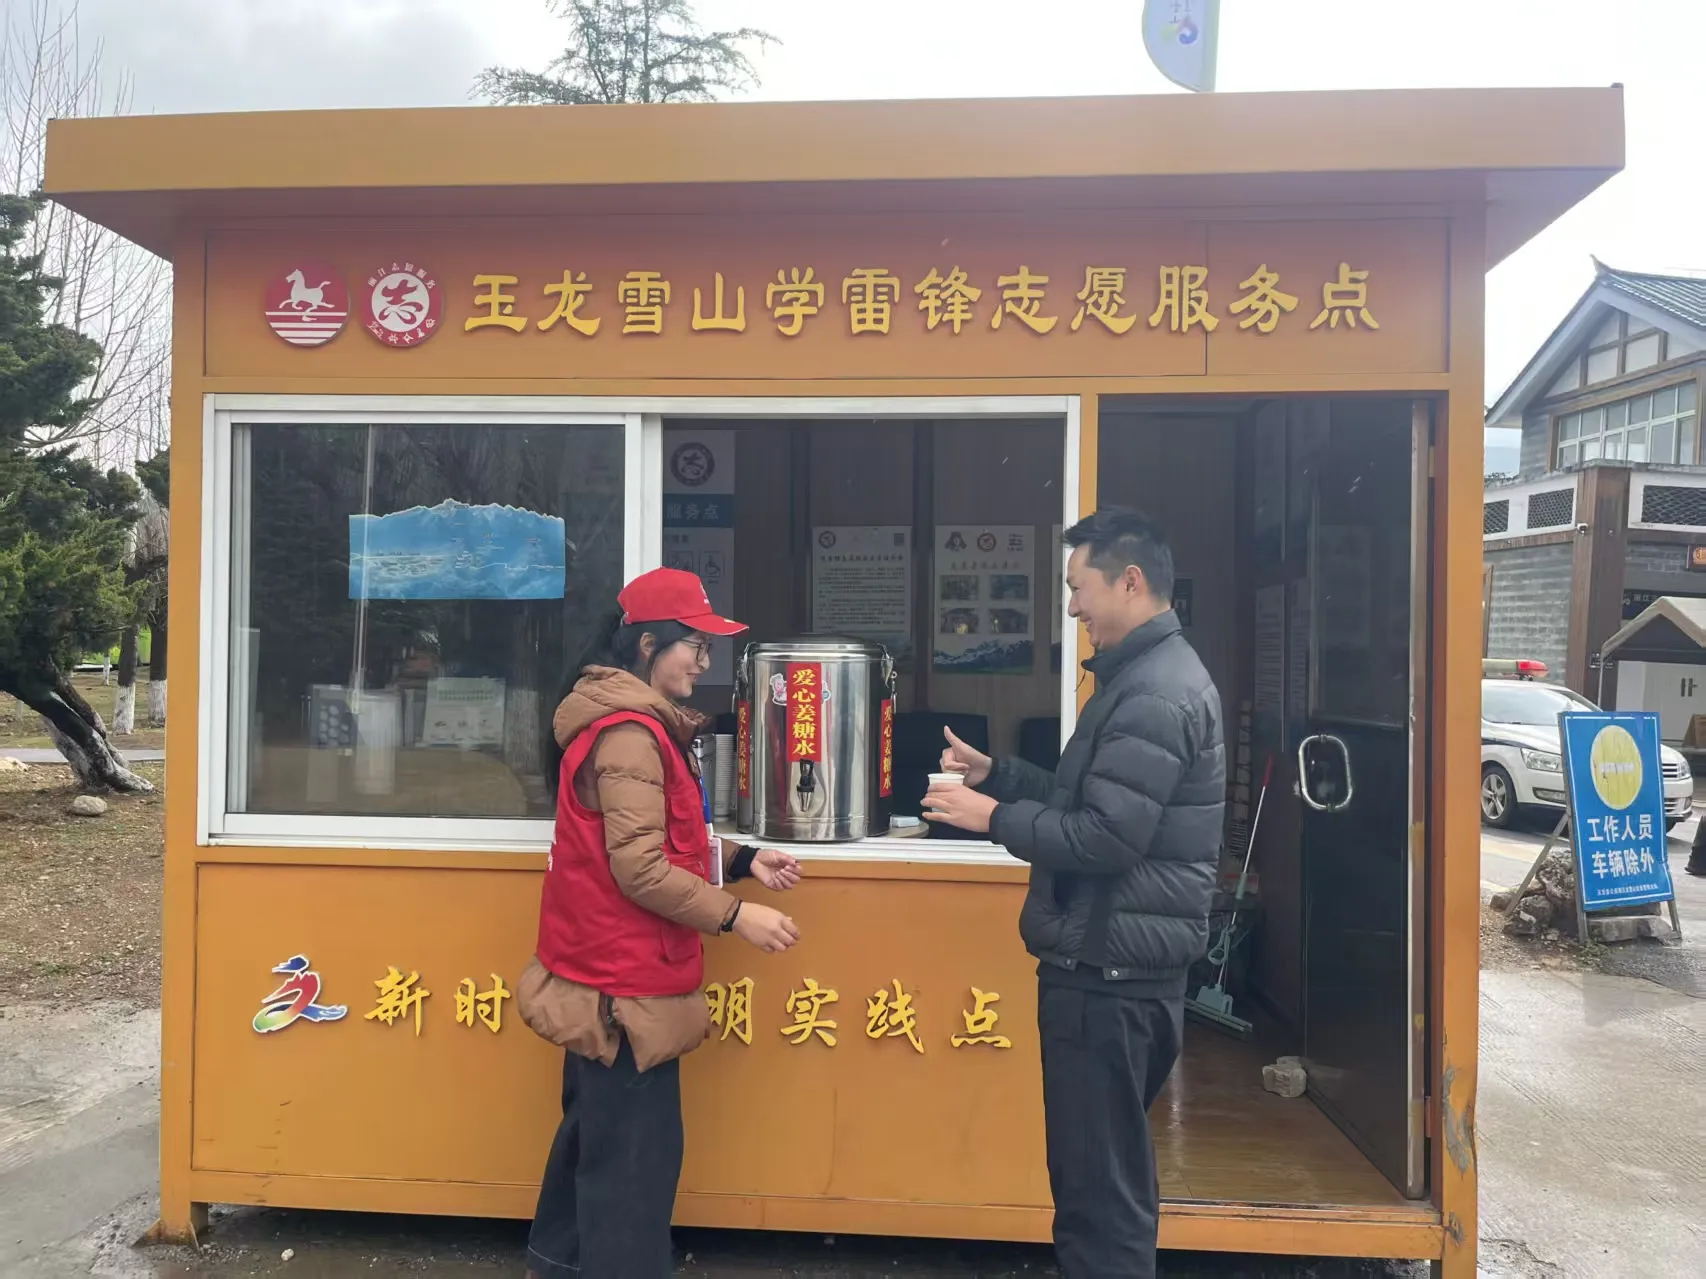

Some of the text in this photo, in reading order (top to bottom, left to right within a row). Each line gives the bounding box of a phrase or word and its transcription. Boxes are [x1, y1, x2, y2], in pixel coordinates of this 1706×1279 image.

[465, 262, 1380, 335] 玉龙雪山学雷锋志愿服务点
[792, 668, 816, 756] 爱心姜糖水
[1587, 814, 1654, 843] 工作人员
[1592, 847, 1655, 879] 车辆除外
[364, 965, 1012, 1053] 新时明实践点
